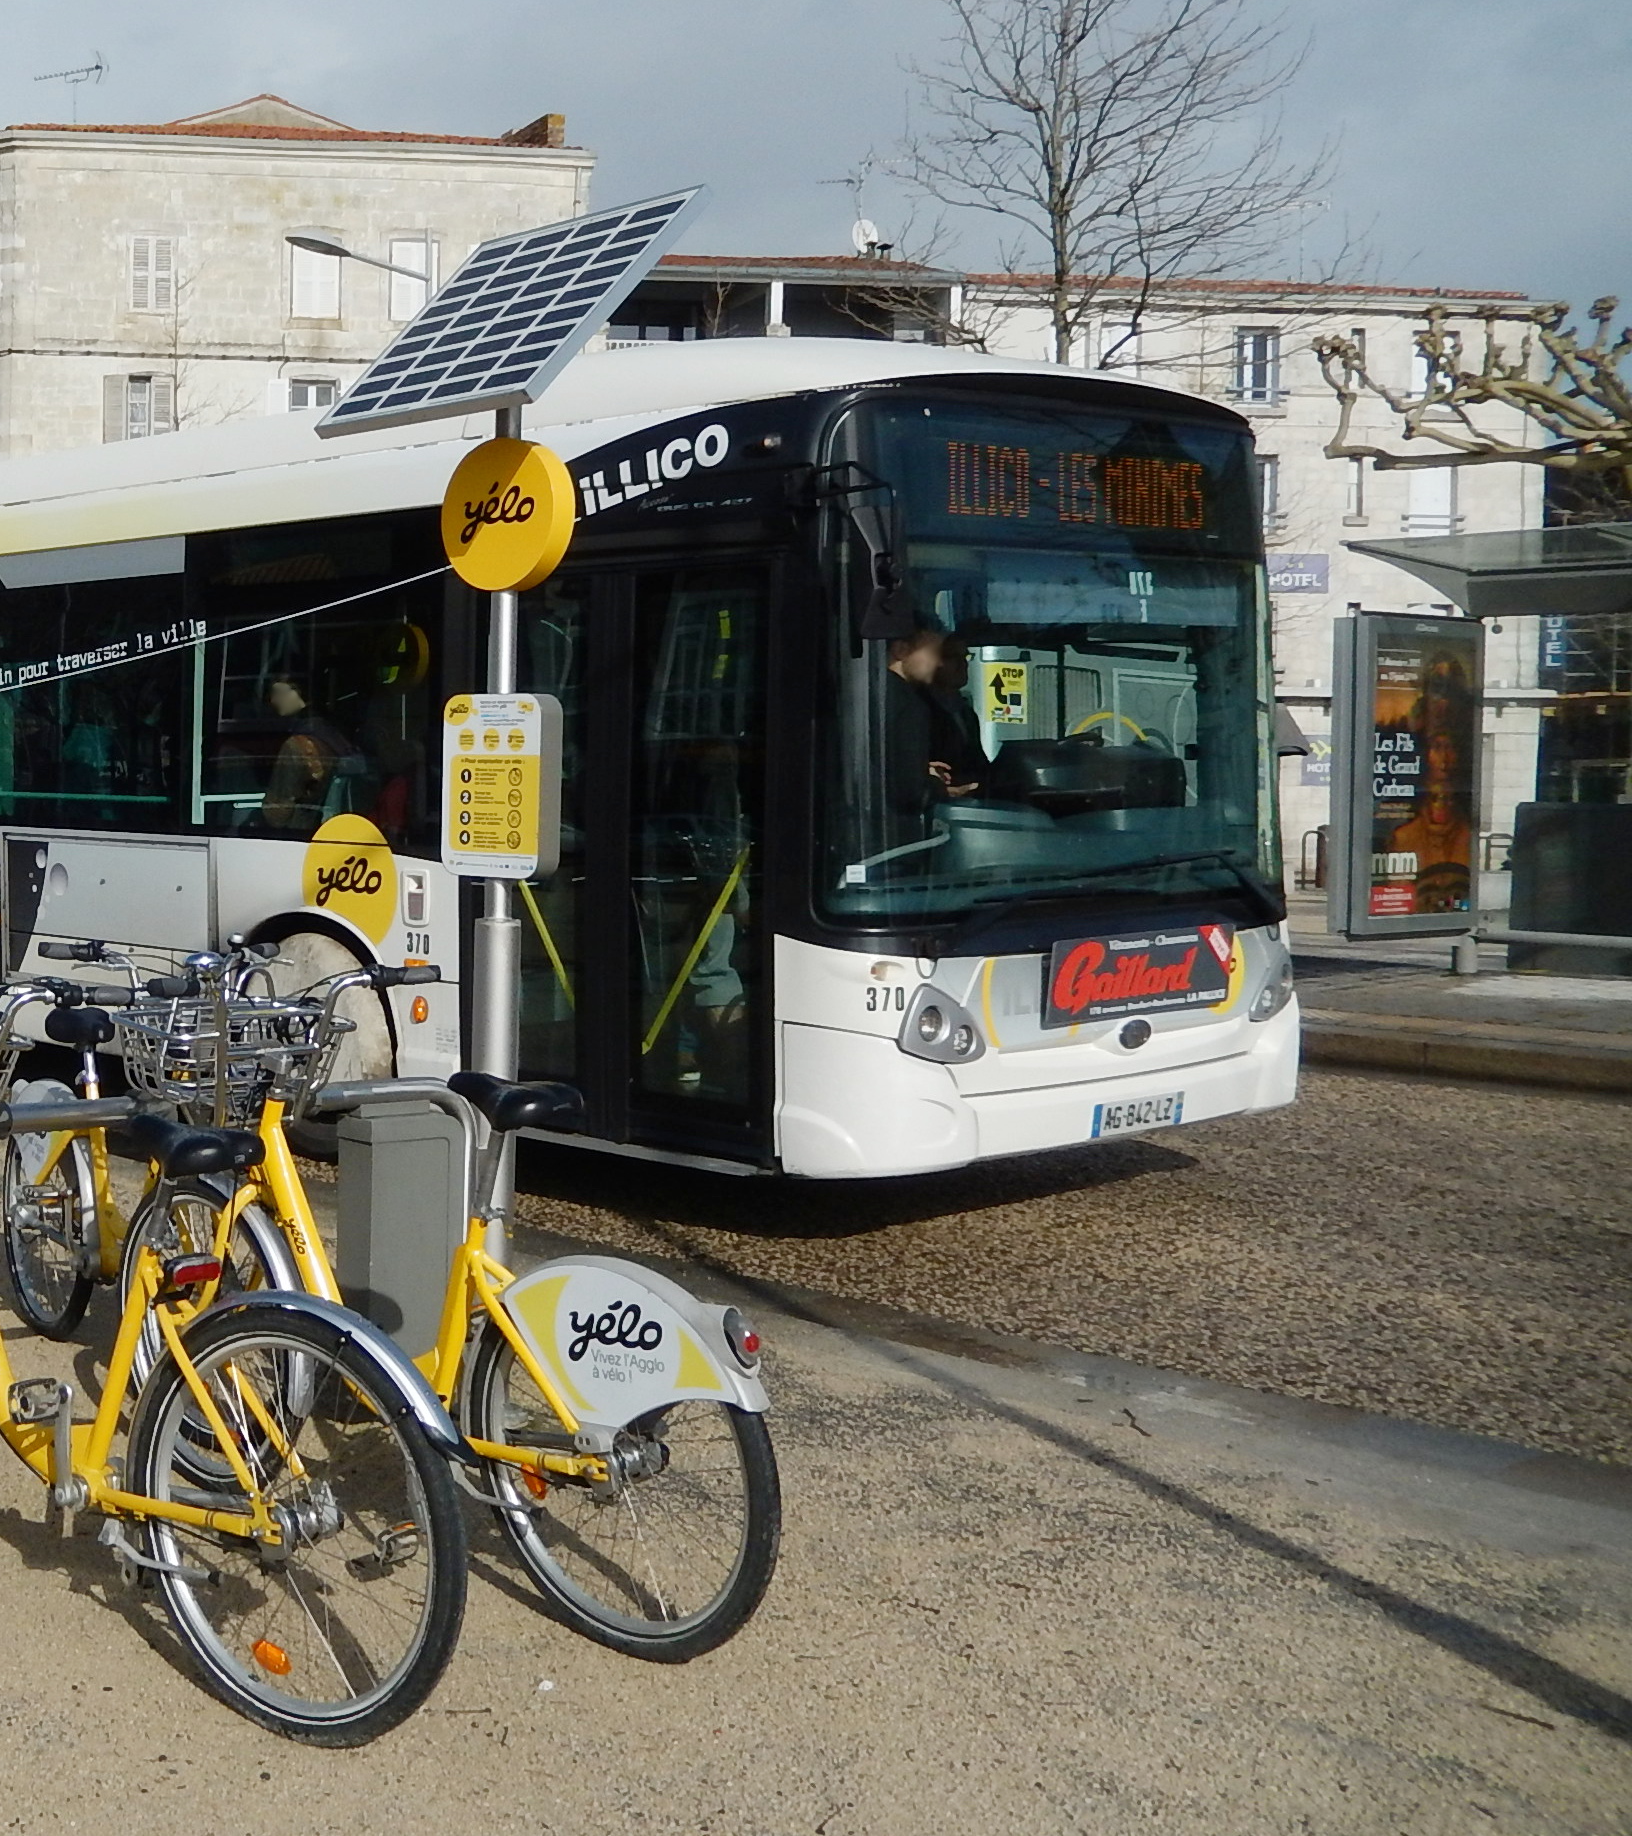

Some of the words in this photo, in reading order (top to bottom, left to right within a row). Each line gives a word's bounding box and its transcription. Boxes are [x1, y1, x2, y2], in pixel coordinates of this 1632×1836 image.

[578, 423, 730, 516] ILLICO
[1058, 452, 1097, 523] LES
[460, 481, 535, 544] yélo
[1269, 573, 1322, 587] HOTEL
[18, 661, 49, 685] pour
[56, 641, 129, 671] traverser
[136, 632, 154, 653] la
[160, 618, 207, 644] ville
[1545, 614, 1563, 667] OTEL
[1001, 667, 1024, 678] STOP
[315, 856, 382, 907] yélo
[406, 931, 430, 955] 370
[866, 986, 905, 1012] 370
[1053, 941, 1198, 1016] Gaillard
[568, 1300, 663, 1361] yélo
[590, 1347, 622, 1367] Vivez
[624, 1354, 666, 1375] l'Agglo
[591, 1365, 600, 1379] à
[601, 1368, 626, 1383] vélo
